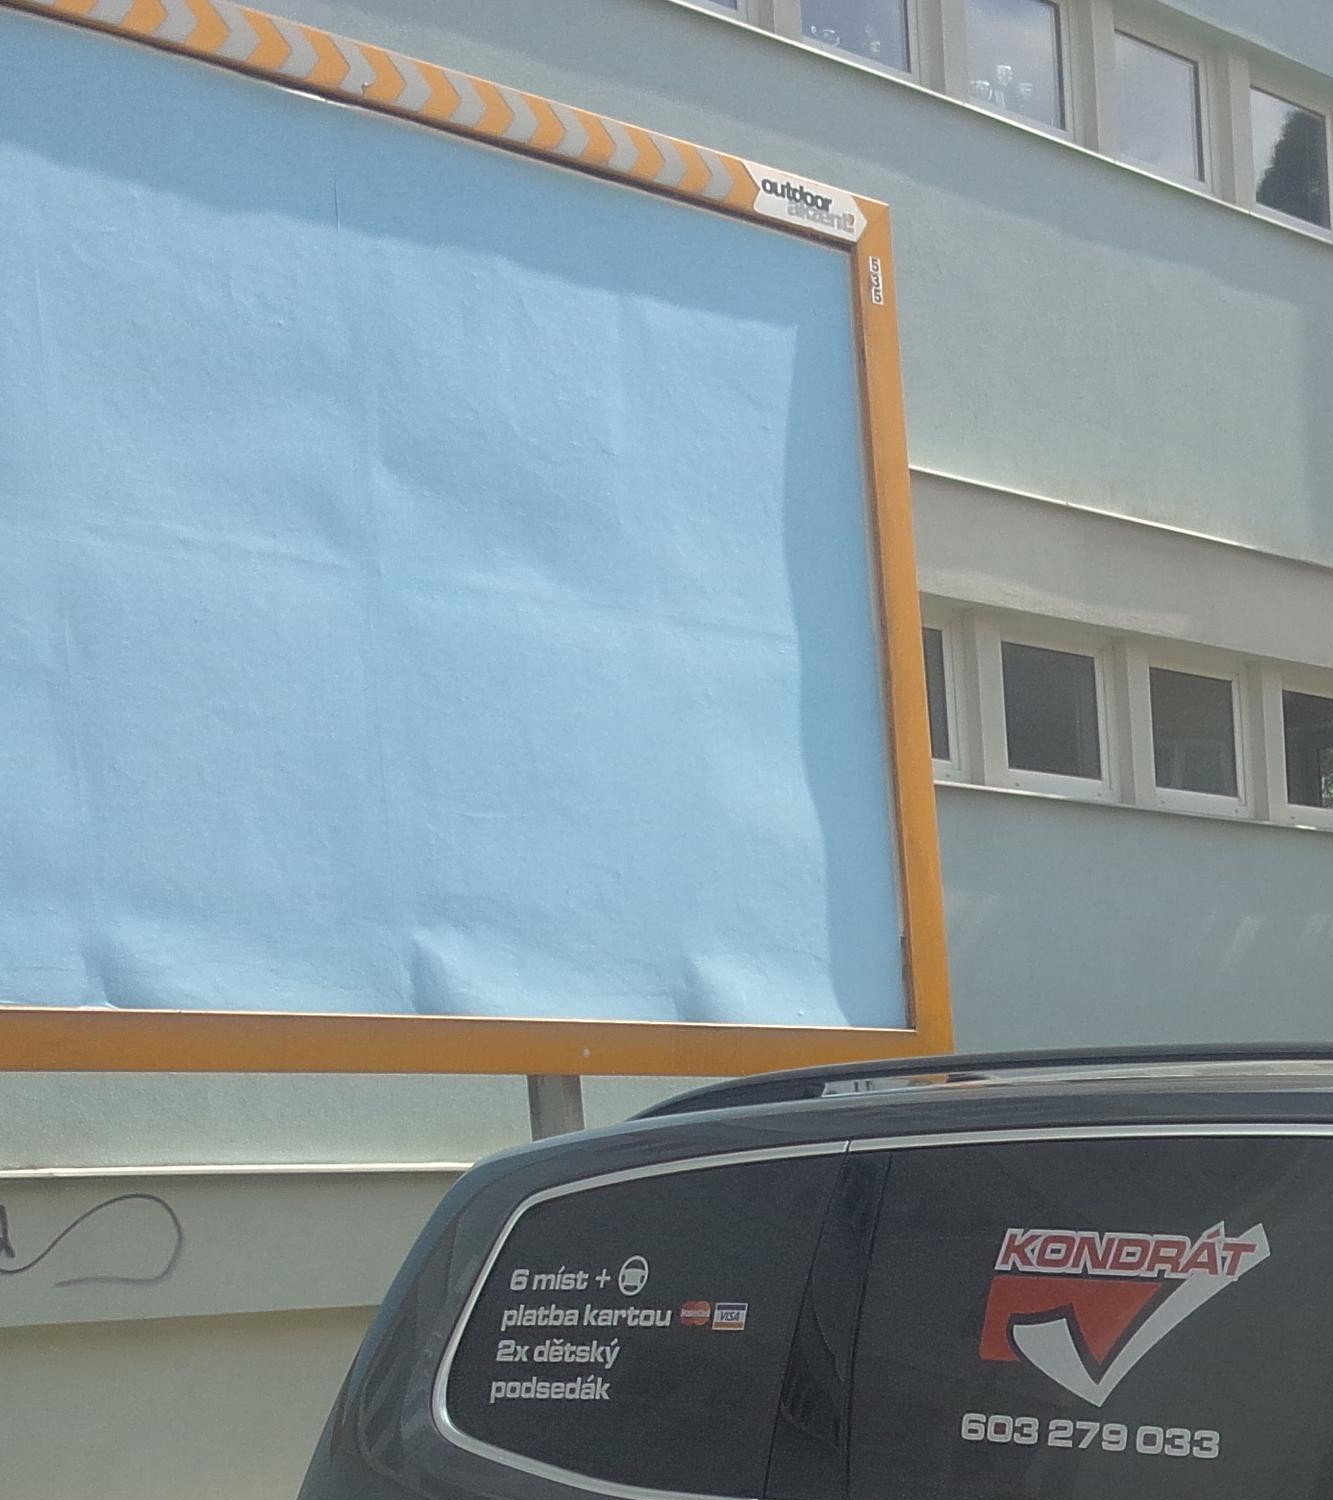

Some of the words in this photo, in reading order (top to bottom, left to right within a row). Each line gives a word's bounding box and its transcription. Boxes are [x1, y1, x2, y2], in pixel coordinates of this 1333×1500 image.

[761, 178, 832, 212] outdoor
[871, 258, 883, 303] 535
[996, 1222, 1257, 1281] KONDRÁT
[509, 1268, 530, 1291] 6
[532, 1265, 589, 1290] míst
[500, 1304, 579, 1331] platba
[583, 1304, 672, 1327] kartou
[721, 1311, 740, 1322] VISA
[496, 1339, 529, 1363] 2x
[533, 1338, 620, 1369] dětský
[490, 1374, 611, 1403] podsedák
[961, 1413, 1040, 1445] 603
[1048, 1419, 1128, 1451] 279
[1136, 1426, 1221, 1459] 033
